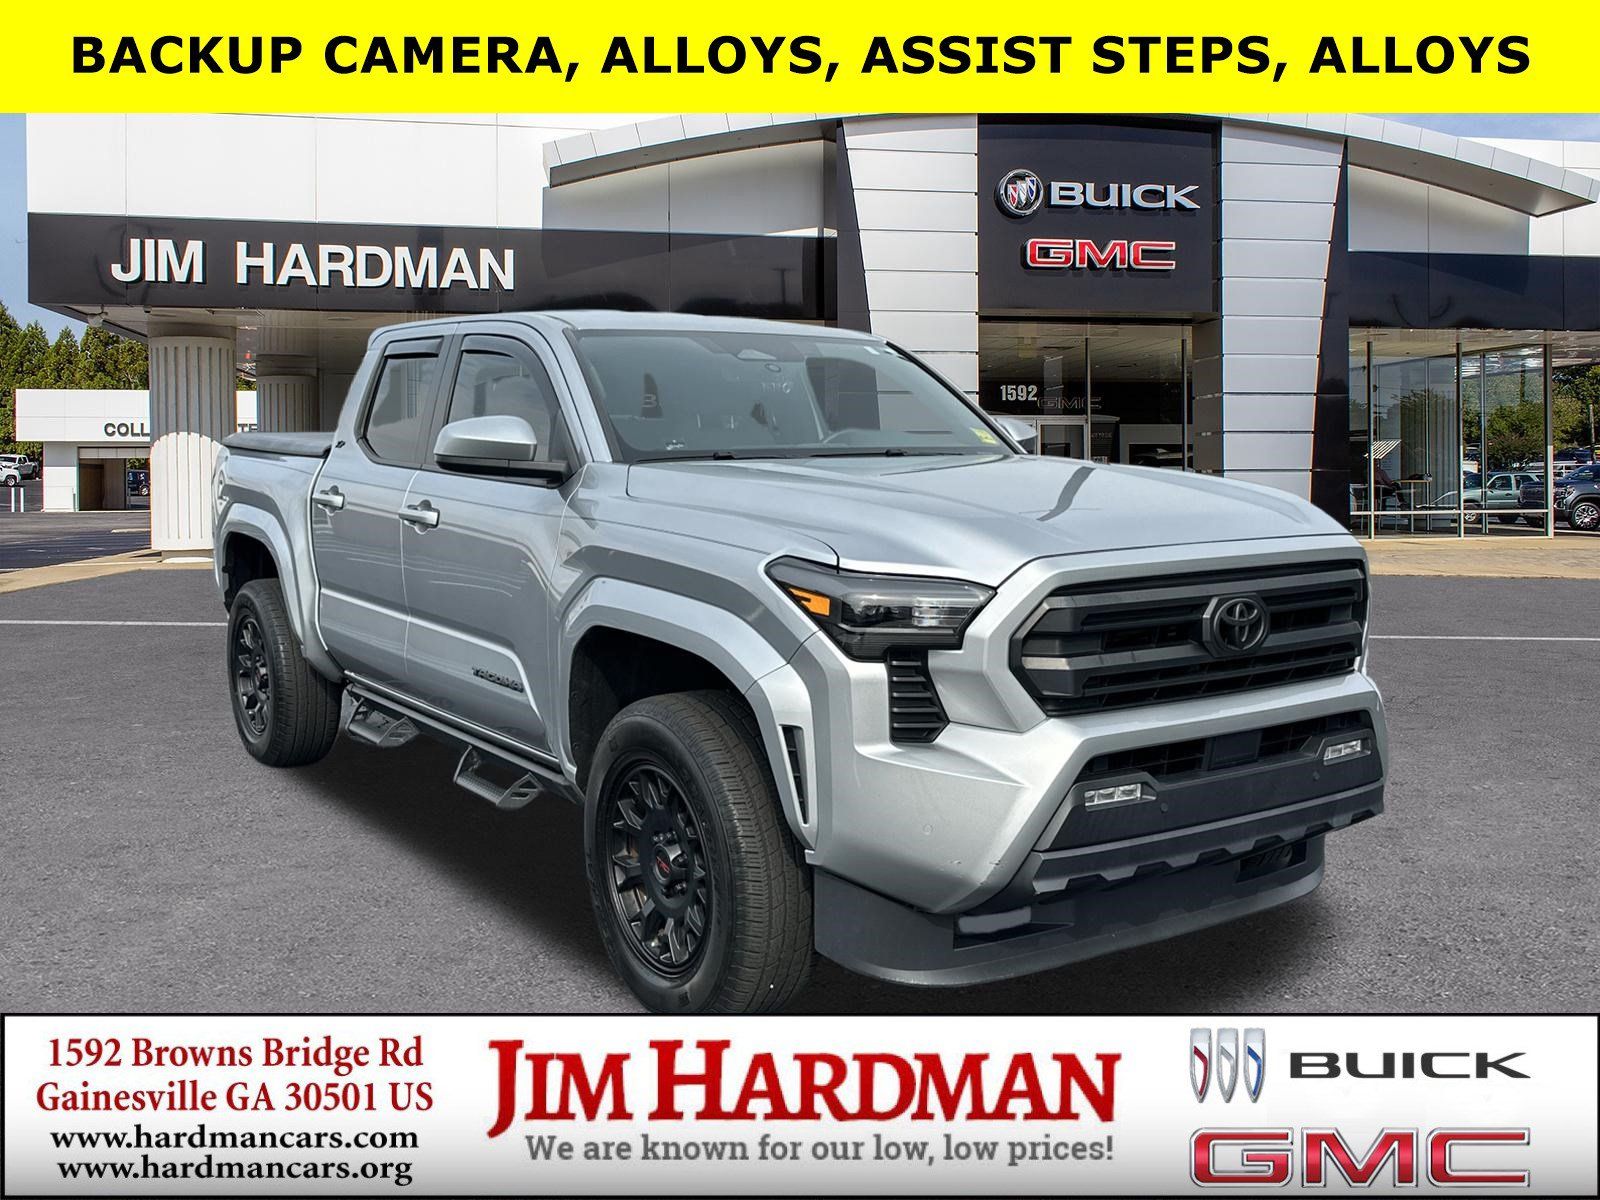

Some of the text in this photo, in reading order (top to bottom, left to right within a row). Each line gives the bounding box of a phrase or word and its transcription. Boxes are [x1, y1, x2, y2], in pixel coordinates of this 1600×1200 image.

[1050, 181, 1200, 209] BUICK
[111, 238, 515, 290] JIM HARDMAN
[1026, 238, 1176, 270] GMC
[1000, 385, 1037, 401] 1592
